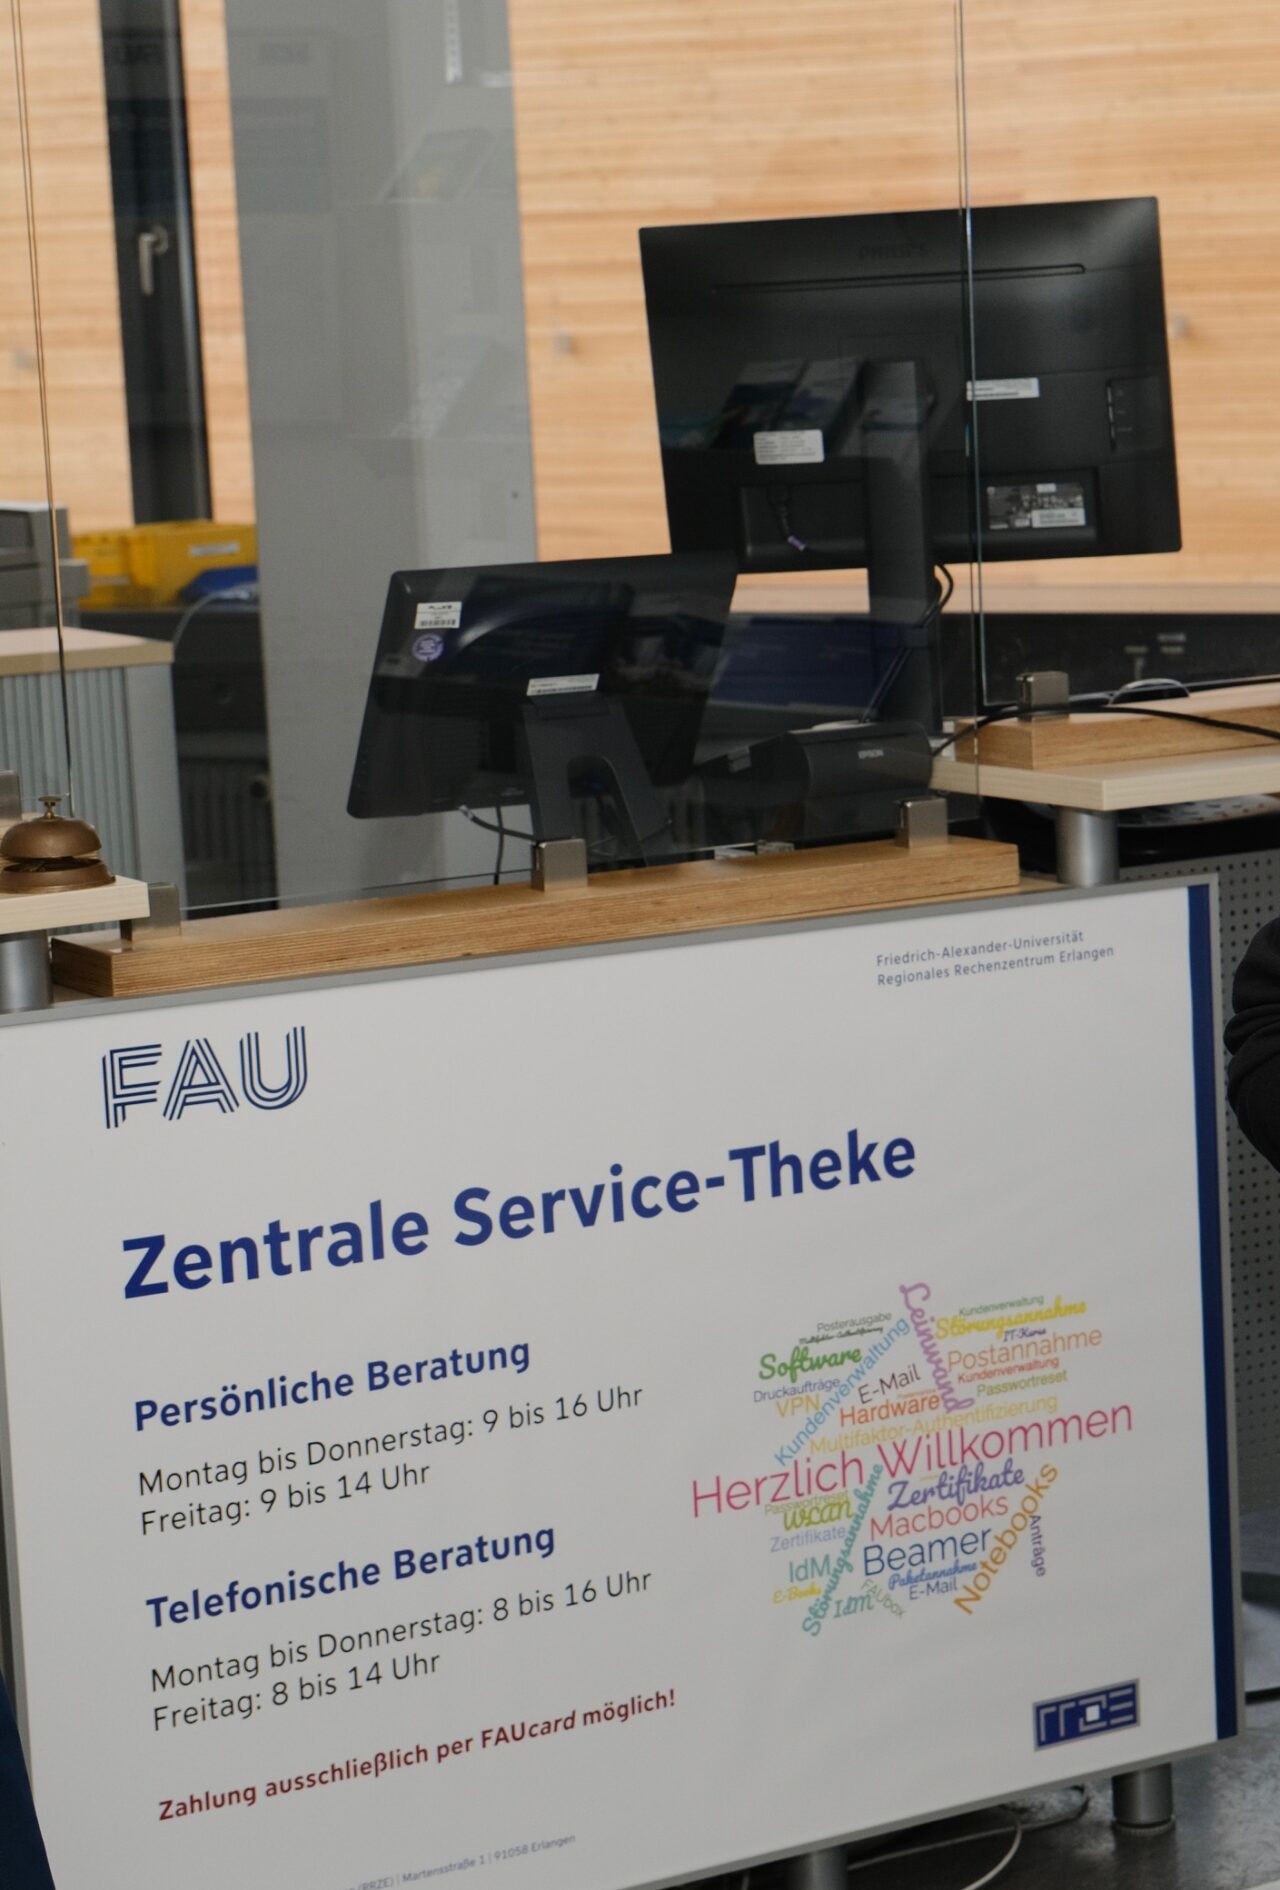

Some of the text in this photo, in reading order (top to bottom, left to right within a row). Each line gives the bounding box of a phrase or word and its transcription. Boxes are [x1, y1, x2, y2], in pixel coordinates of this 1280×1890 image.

[876, 930, 1085, 967] Friedrich-Alexander-Universität
[877, 946, 1115, 988] Regionales Rechenzentrum Erlangen
[101, 1025, 308, 1130] FAU
[122, 1127, 917, 1300] Zentrale Service-Theke
[816, 1311, 893, 1333] Posterausgabe
[958, 1295, 1045, 1317] Kundenverwaltung
[758, 1344, 863, 1385] Software
[899, 1282, 975, 1414] Leinwand
[947, 1328, 1104, 1373] Postannahme
[957, 1356, 1060, 1384] Kundenverwaltung
[134, 1341, 531, 1432] Persönliche Beratung
[753, 1377, 841, 1403] Druckaufträge
[774, 1317, 911, 1467] Kundenverwaltung
[776, 1392, 823, 1419] VPN
[857, 1363, 921, 1405] E-Mail
[976, 1369, 1068, 1398] Passwortreset
[809, 1395, 1059, 1455] Multifaktor-Authentifizierung
[839, 1393, 940, 1428] Hardware
[138, 1385, 644, 1497] Montag bis Donnerstag: 9 bis 16 Uhr
[692, 1404, 1134, 1519] Herzlich Willkommen
[141, 1462, 431, 1536] Freitag: 9 bis 14 Uhr
[887, 1457, 1025, 1511] Zertifikate
[770, 1526, 847, 1553] Zertifikate
[869, 1494, 1009, 1542] Macbooks
[953, 1463, 1059, 1616] Notebooks
[788, 1554, 832, 1583] IdM
[802, 1463, 885, 1637] Störungsannahme
[863, 1528, 992, 1577] Beamer
[1029, 1514, 1047, 1578] Anträge
[146, 1527, 556, 1628] Telefonische Beratung
[909, 1577, 958, 1601] E-Mail
[151, 1570, 653, 1692] Montag bis Donnerstag: 8 bis 16 Uhr
[152, 1651, 441, 1731] Freitag: 8 bis 14 Uhr
[158, 1689, 677, 1822] Zahlung ausschließlich per FAUcard möglich!
[402, 1858, 476, 1883] Martensstraße
[479, 1855, 486, 1866] 1
[494, 1844, 530, 1861] 91058
[531, 1834, 577, 1853] Erlangen
